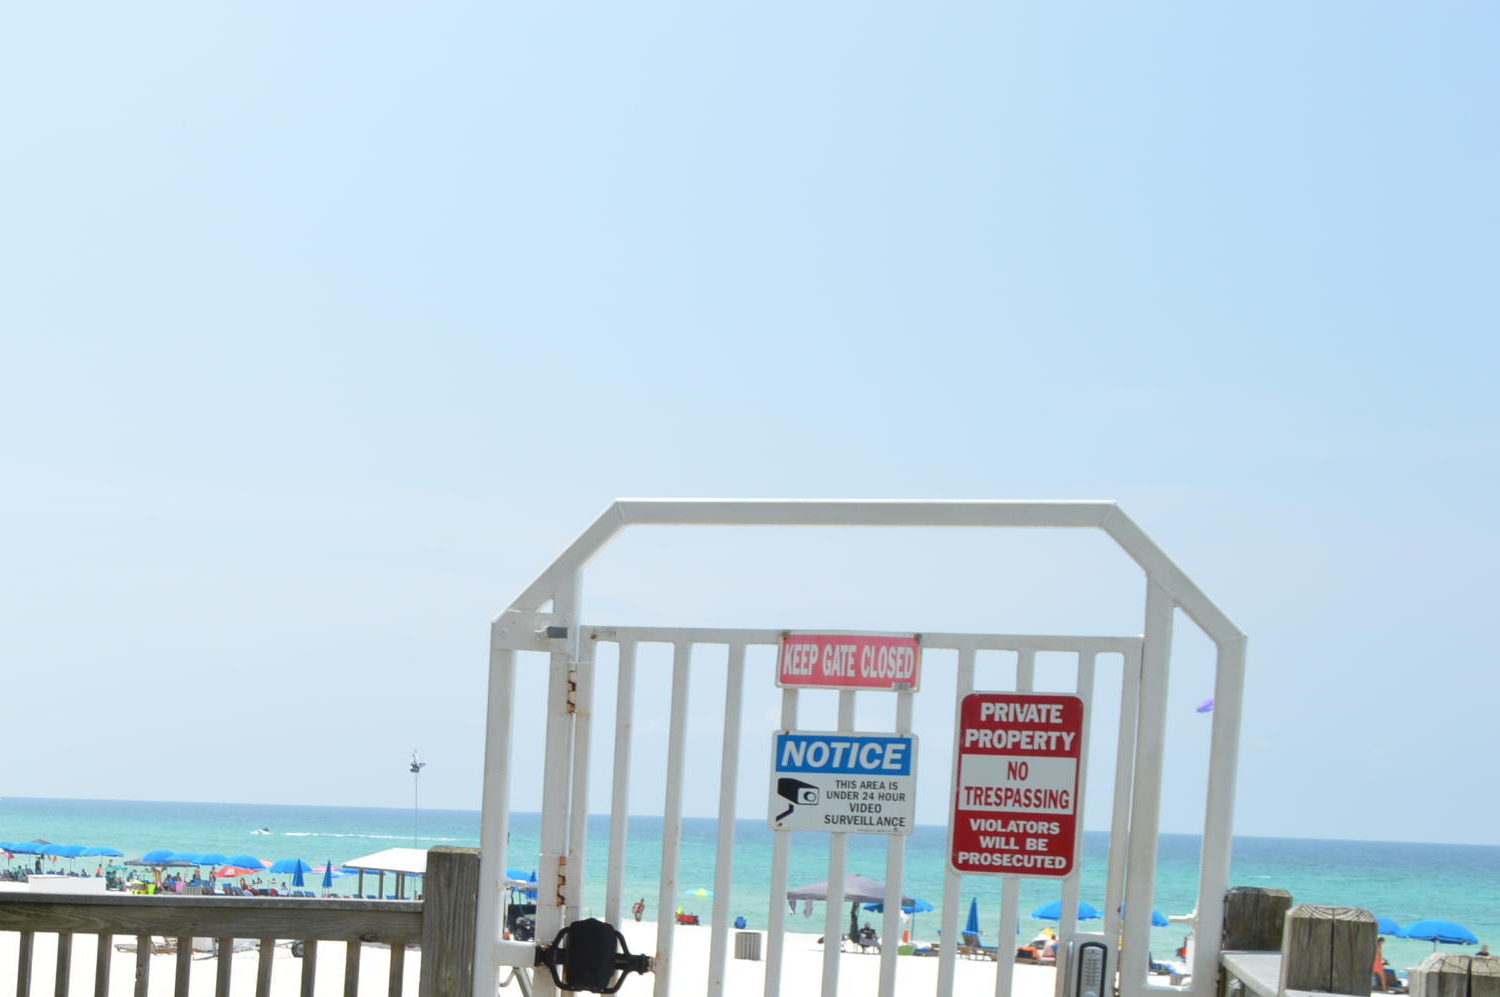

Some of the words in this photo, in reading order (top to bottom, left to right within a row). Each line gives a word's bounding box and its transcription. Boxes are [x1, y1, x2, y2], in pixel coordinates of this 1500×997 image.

[782, 643, 819, 676] KEEP
[822, 643, 858, 677] GATE
[860, 645, 915, 679] CLOSED
[980, 702, 1064, 724] PRIVATE
[964, 728, 1076, 751] PROPERTY
[781, 740, 907, 770] NOTICE
[1007, 760, 1029, 781] NO
[835, 780, 857, 790] THIS
[859, 780, 886, 791] AREA
[888, 781, 899, 791] IS
[826, 791, 860, 801] UNDER
[862, 792, 875, 802] 24
[877, 793, 906, 803] HOUR
[964, 786, 1070, 810] TRESPASSING
[849, 803, 882, 814] VIDEO
[824, 814, 907, 828] SURVEILLANCE
[969, 818, 1061, 835] VIOLATORS
[979, 836, 1020, 850] WILL
[1025, 838, 1049, 851] BE
[957, 852, 1068, 870] PROSECUTED
